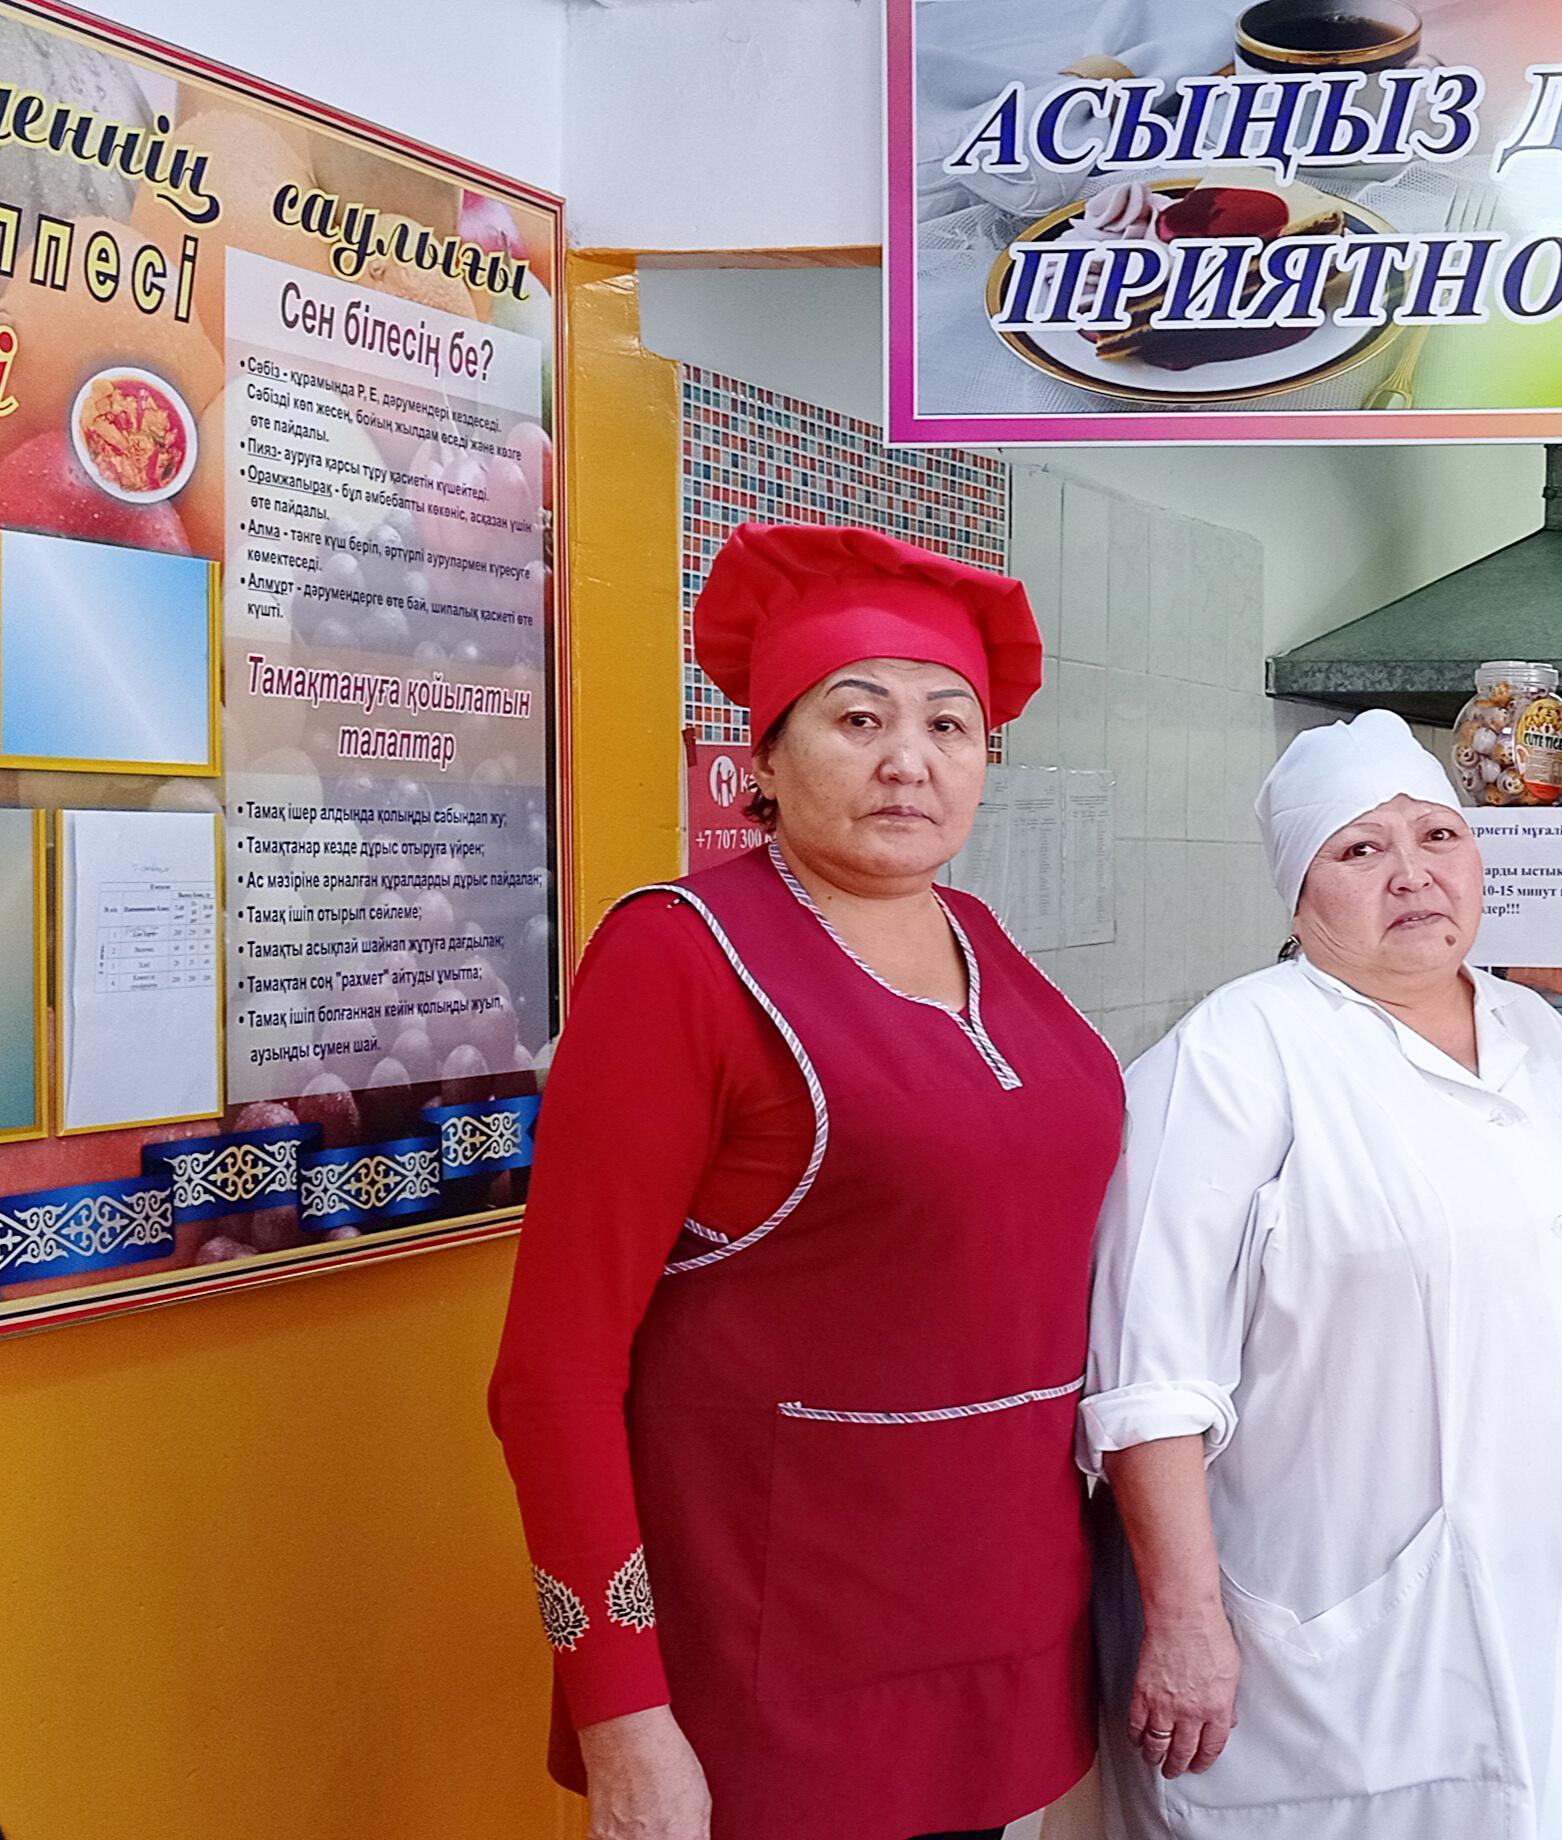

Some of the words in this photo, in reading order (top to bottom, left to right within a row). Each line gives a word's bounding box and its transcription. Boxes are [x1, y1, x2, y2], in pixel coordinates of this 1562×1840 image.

[951, 73, 1478, 178] АСЫҢЫЗ
[273, 184, 530, 300] саулығы
[281, 282, 335, 339] Сен
[344, 300, 440, 378] білесің
[449, 331, 494, 381] бе?
[247, 357, 280, 379] Сәбіз
[290, 370, 354, 397] құрамында
[382, 394, 450, 423] дәрумендері
[452, 411, 501, 434] кездеседі.
[247, 384, 290, 408] Сәбізді
[293, 396, 313, 413] көп
[356, 409, 393, 433] бойың
[395, 420, 439, 442] жылдам
[441, 432, 468, 450] өседі
[470, 438, 494, 455] және
[497, 446, 522, 462] көзге
[250, 415, 270, 430] өте
[274, 419, 329, 443] пайдалы.
[284, 448, 322, 468] ауруға
[325, 456, 360, 475] қарсы
[362, 464, 388, 484] тұру
[389, 471, 434, 489] қасиетін
[436, 481, 489, 502] күшейтеді.
[247, 464, 332, 497] Орамжапырақ
[341, 484, 362, 502] бұл
[365, 491, 425, 513] әмбебапты
[427, 503, 467, 523] көкөніс,
[470, 511, 508, 529] асқазан
[509, 519, 532, 533] үшін
[251, 495, 271, 508] өте
[274, 499, 330, 521] пайдалы.
[247, 519, 280, 538] Алма
[291, 529, 321, 545] тәнге
[324, 536, 346, 551] күш
[348, 536, 381, 557] беріп,
[384, 544, 425, 564] әртүрлі
[427, 551, 487, 573] аурулармен
[489, 562, 531, 581] күресуге
[247, 547, 322, 572] көмектеседі.
[247, 572, 294, 596] Алмұрт
[304, 582, 384, 606] дәрумендерге
[386, 595, 404, 609] өте
[407, 595, 429, 614] бай,
[431, 603, 479, 621] шипалық
[481, 608, 515, 625] қасиеті
[517, 613, 533, 627] өте
[247, 602, 283, 619] күшті.
[247, 654, 401, 715] Тамақтануға
[406, 673, 531, 719] қойылатын
[339, 725, 455, 771] талаптар
[1523, 732, 1545, 748] CUTE
[246, 801, 286, 822] Тамақ
[288, 802, 317, 824] ішер
[320, 808, 375, 824] алдында
[434, 808, 487, 825] сабындап
[490, 812, 507, 829] жу;
[246, 836, 320, 858] Тамақтанар
[323, 841, 357, 857] кезде
[360, 841, 398, 858] дұрыс
[401, 842, 447, 859] отыруға
[450, 839, 485, 859] үйрен;
[695, 829, 712, 850] +7
[715, 829, 737, 850] 707
[740, 828, 762, 849] 300
[246, 871, 264, 888] Ас
[267, 871, 320, 892] мәзіріне
[323, 875, 378, 891] арналған
[381, 874, 450, 891] құралдарды
[453, 873, 488, 890] дұрыс
[490, 870, 542, 888] пайдалан;
[1482, 885, 1514, 897] 10-15
[1517, 887, 1556, 899] минут
[246, 906, 286, 925] Тамақ
[288, 905, 314, 922] ішіп
[317, 908, 366, 925] отырып
[369, 903, 422, 921] сөйлеме;
[247, 941, 303, 959] Тамақты
[306, 937, 358, 957] асықпай
[362, 936, 406, 953] шайнап
[408, 937, 446, 955] жұтуға
[247, 976, 307, 993] Тамақтан
[310, 976, 333, 991] соң
[336, 968, 389, 992] "рахмет"
[392, 967, 434, 987] айтуды
[437, 967, 482, 985] ұмытпа;
[247, 1010, 287, 1028] Тамақ
[290, 1007, 315, 1025] ішіп
[318, 1004, 382, 1023] болғаннан
[384, 1000, 414, 1017] кейін
[471, 996, 503, 1014] жуып,
[250, 1044, 310, 1066] аузыңды
[313, 1041, 351, 1060] сумен
[353, 1035, 380, 1053] шай.
